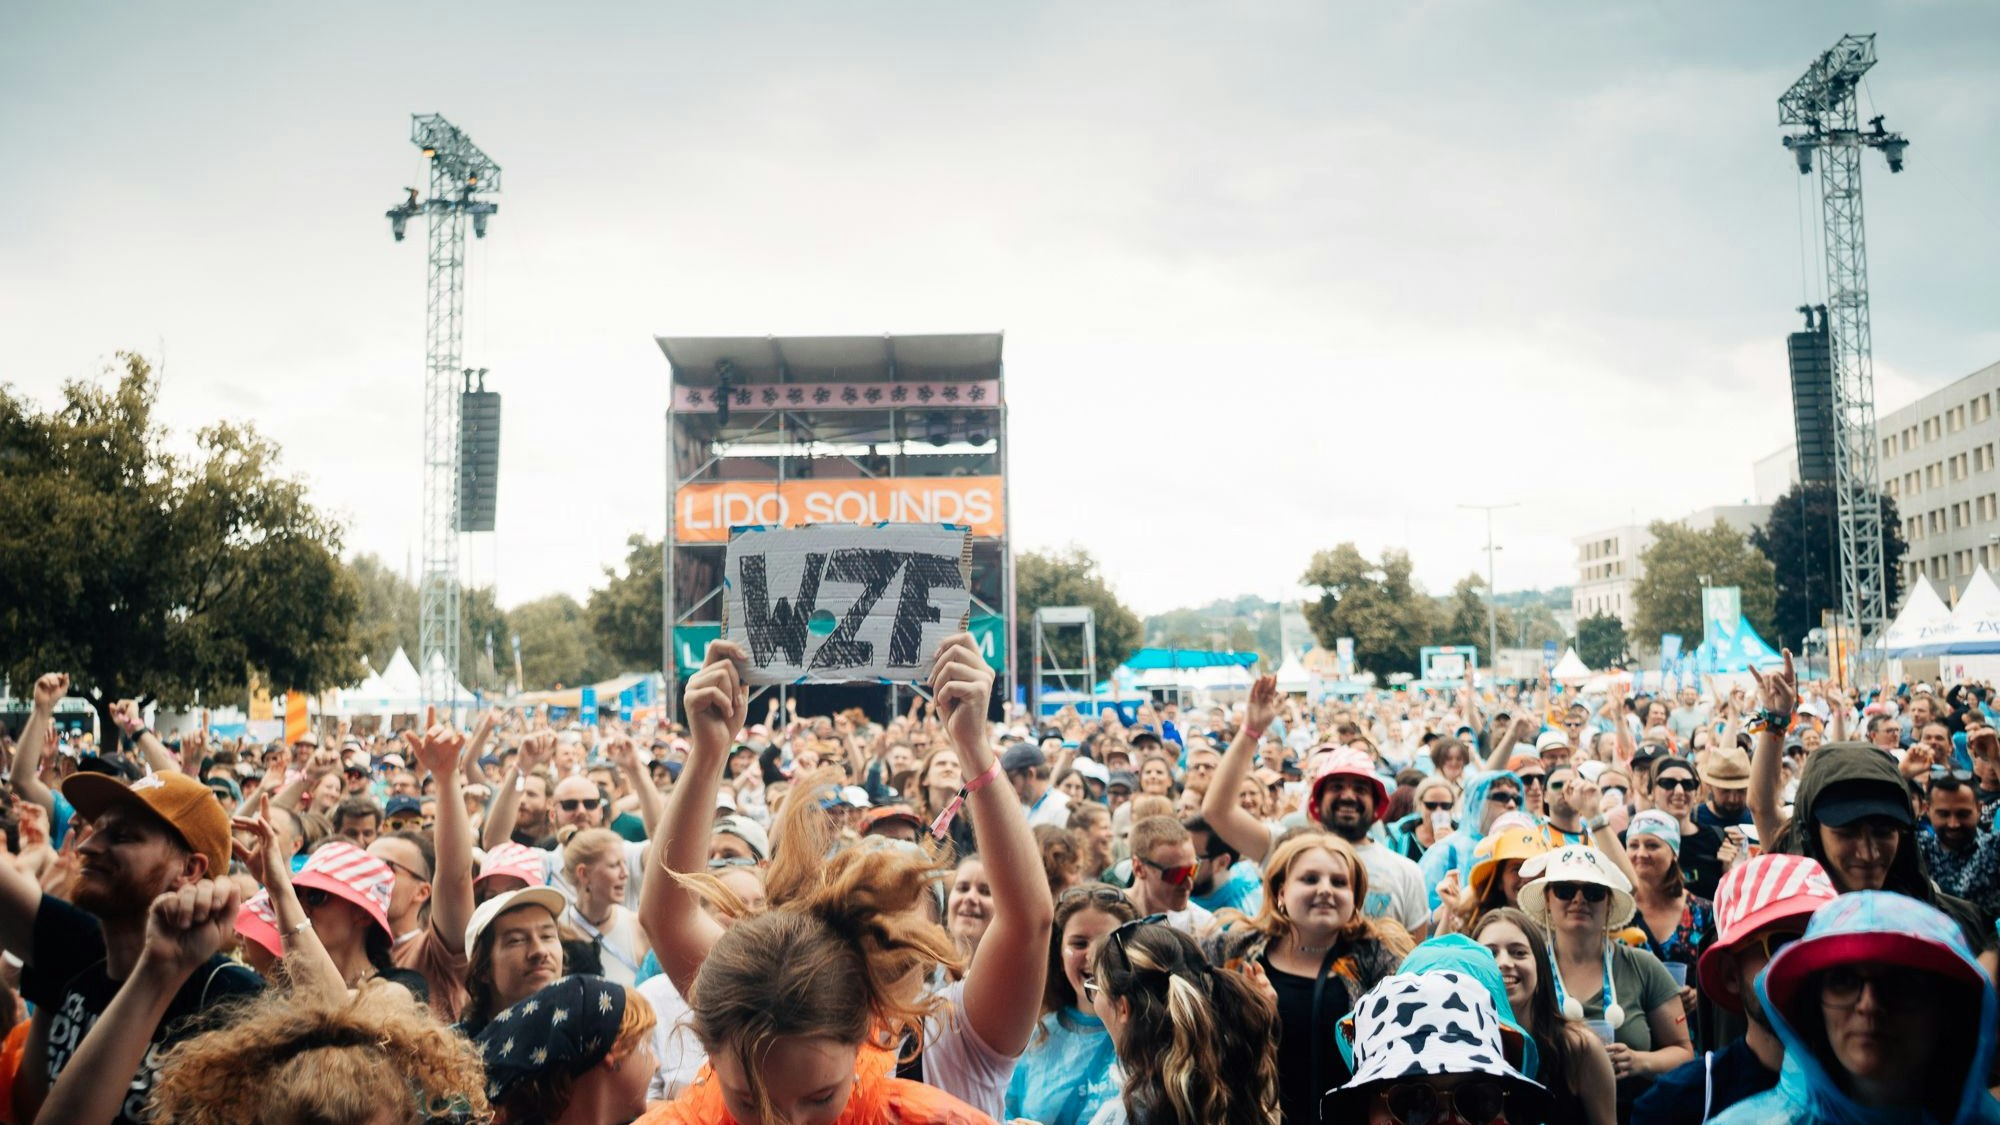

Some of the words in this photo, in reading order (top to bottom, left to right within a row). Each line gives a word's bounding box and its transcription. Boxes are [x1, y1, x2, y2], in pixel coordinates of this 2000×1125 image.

[684, 491, 789, 529] LIDO
[804, 488, 993, 526] SOUNDS
[739, 548, 965, 671] WZF
